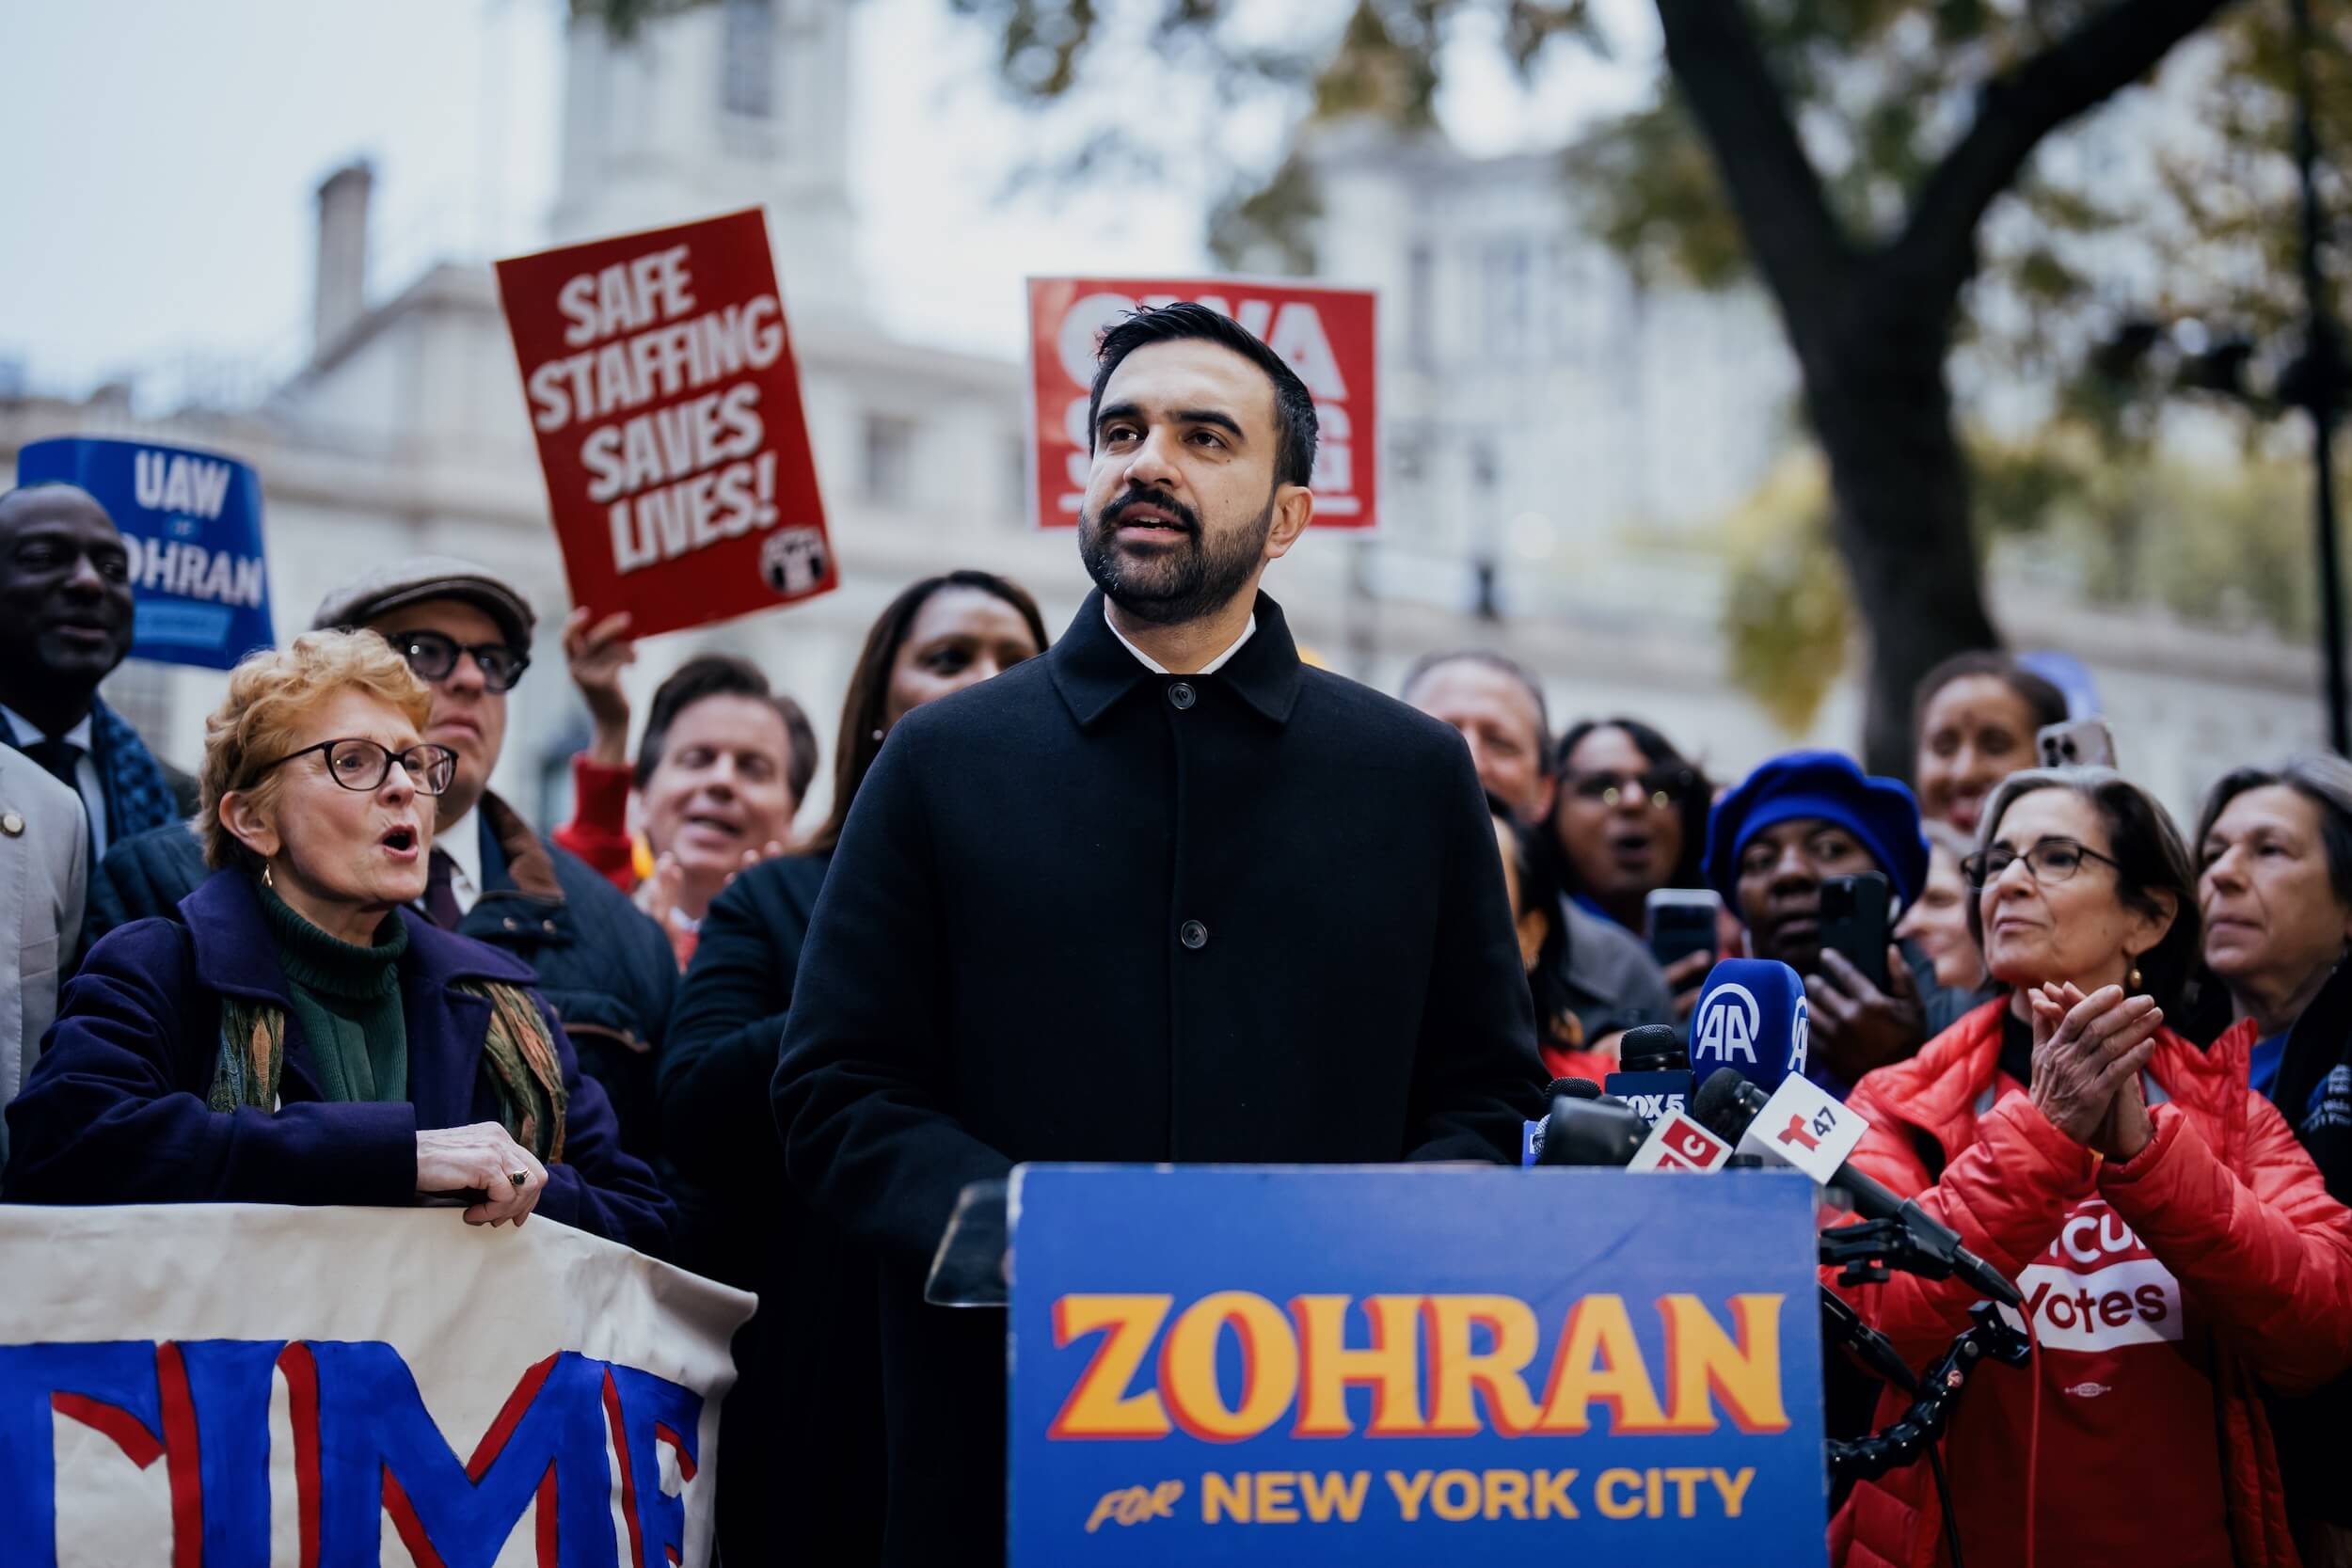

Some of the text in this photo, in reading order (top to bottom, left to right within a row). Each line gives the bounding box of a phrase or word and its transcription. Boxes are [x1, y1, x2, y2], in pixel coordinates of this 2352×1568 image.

[557, 243, 696, 346] SAFE
[529, 294, 785, 432] STAFFING
[134, 449, 231, 520] UAW
[580, 382, 764, 503] SAVES
[609, 451, 779, 576] LIVES!
[120, 531, 263, 610] OHRAN
[1613, 1094, 1664, 1119] OX
[1813, 1105, 1836, 1136] 47
[1046, 1290, 1791, 1444] ZOHRAN
[1087, 1467, 1756, 1532] FOR NEW YORK CITY
